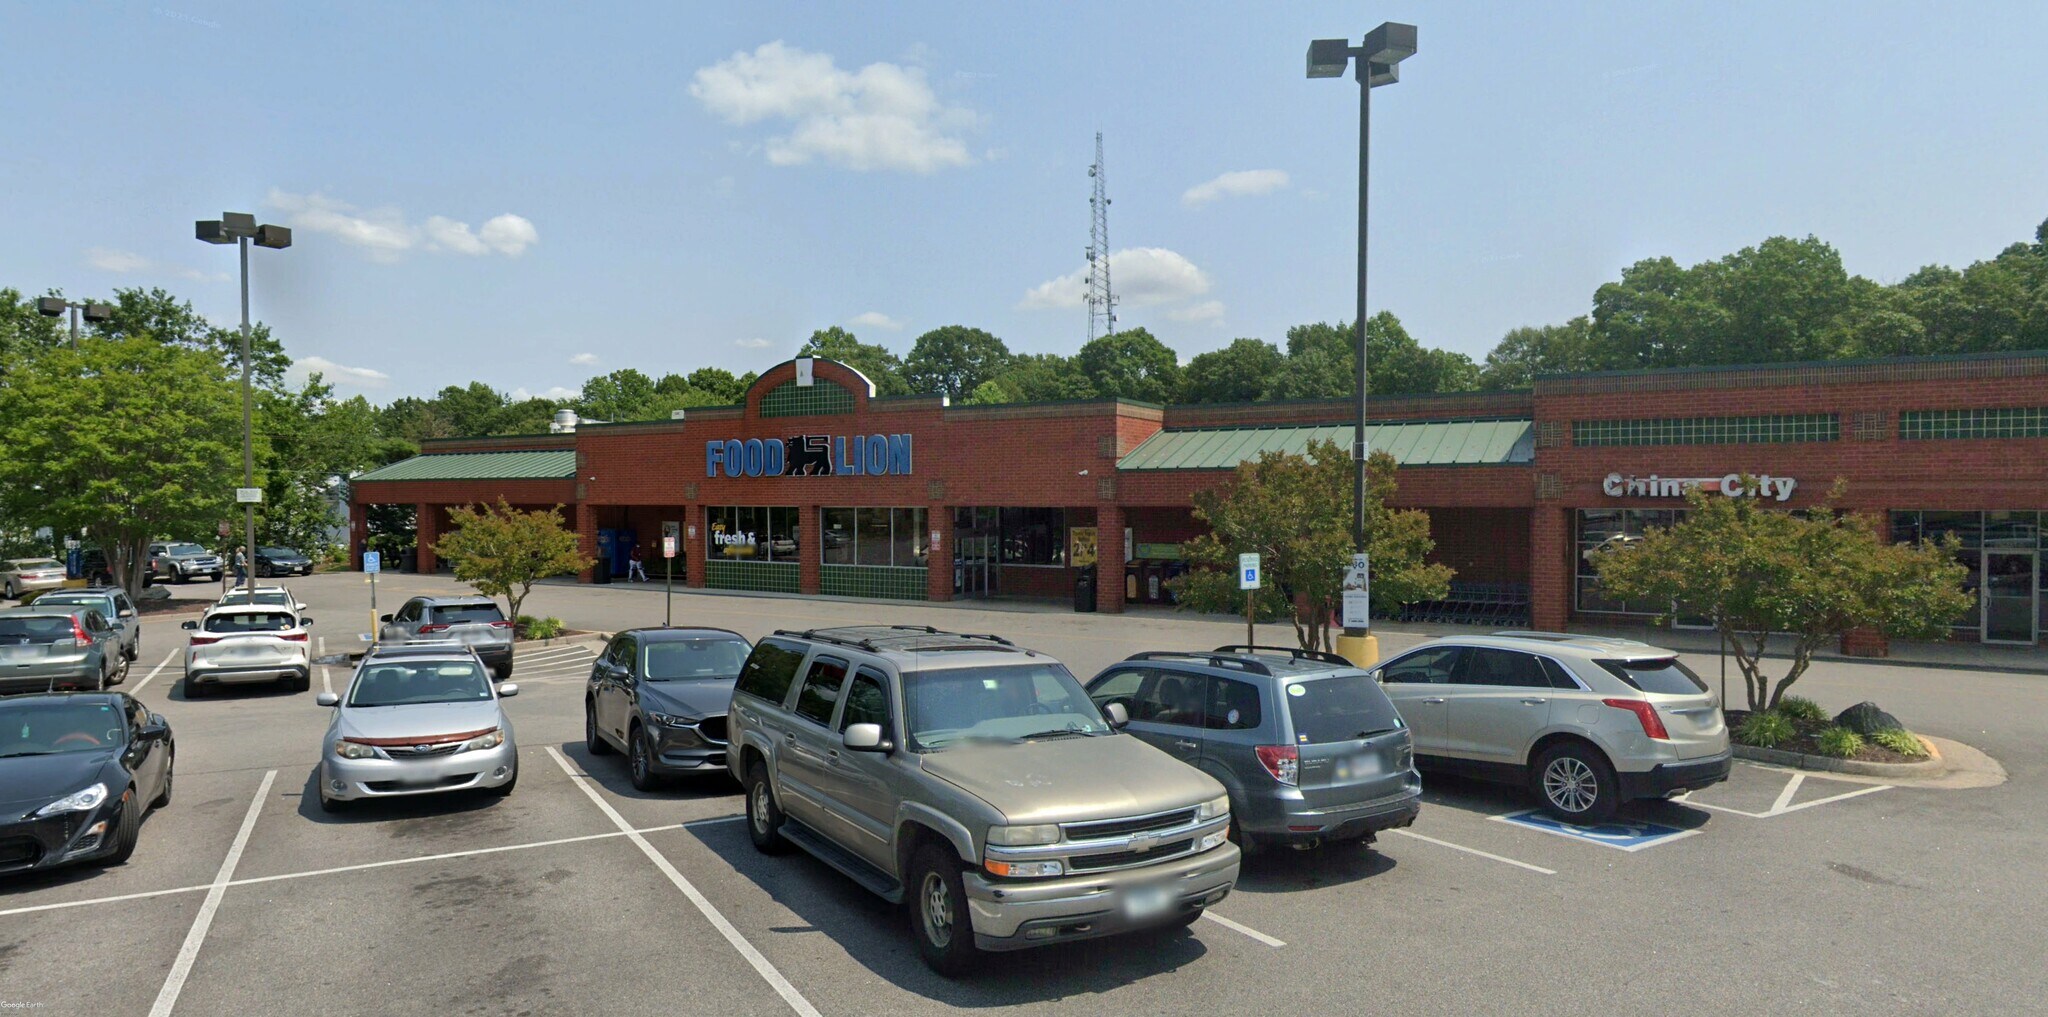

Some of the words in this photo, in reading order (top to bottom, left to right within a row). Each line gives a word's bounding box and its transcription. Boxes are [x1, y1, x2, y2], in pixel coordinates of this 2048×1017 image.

[706, 438, 785, 477] FOOD
[835, 434, 913, 476] LION
[714, 530, 746, 545] fresh
[747, 531, 756, 545] &
